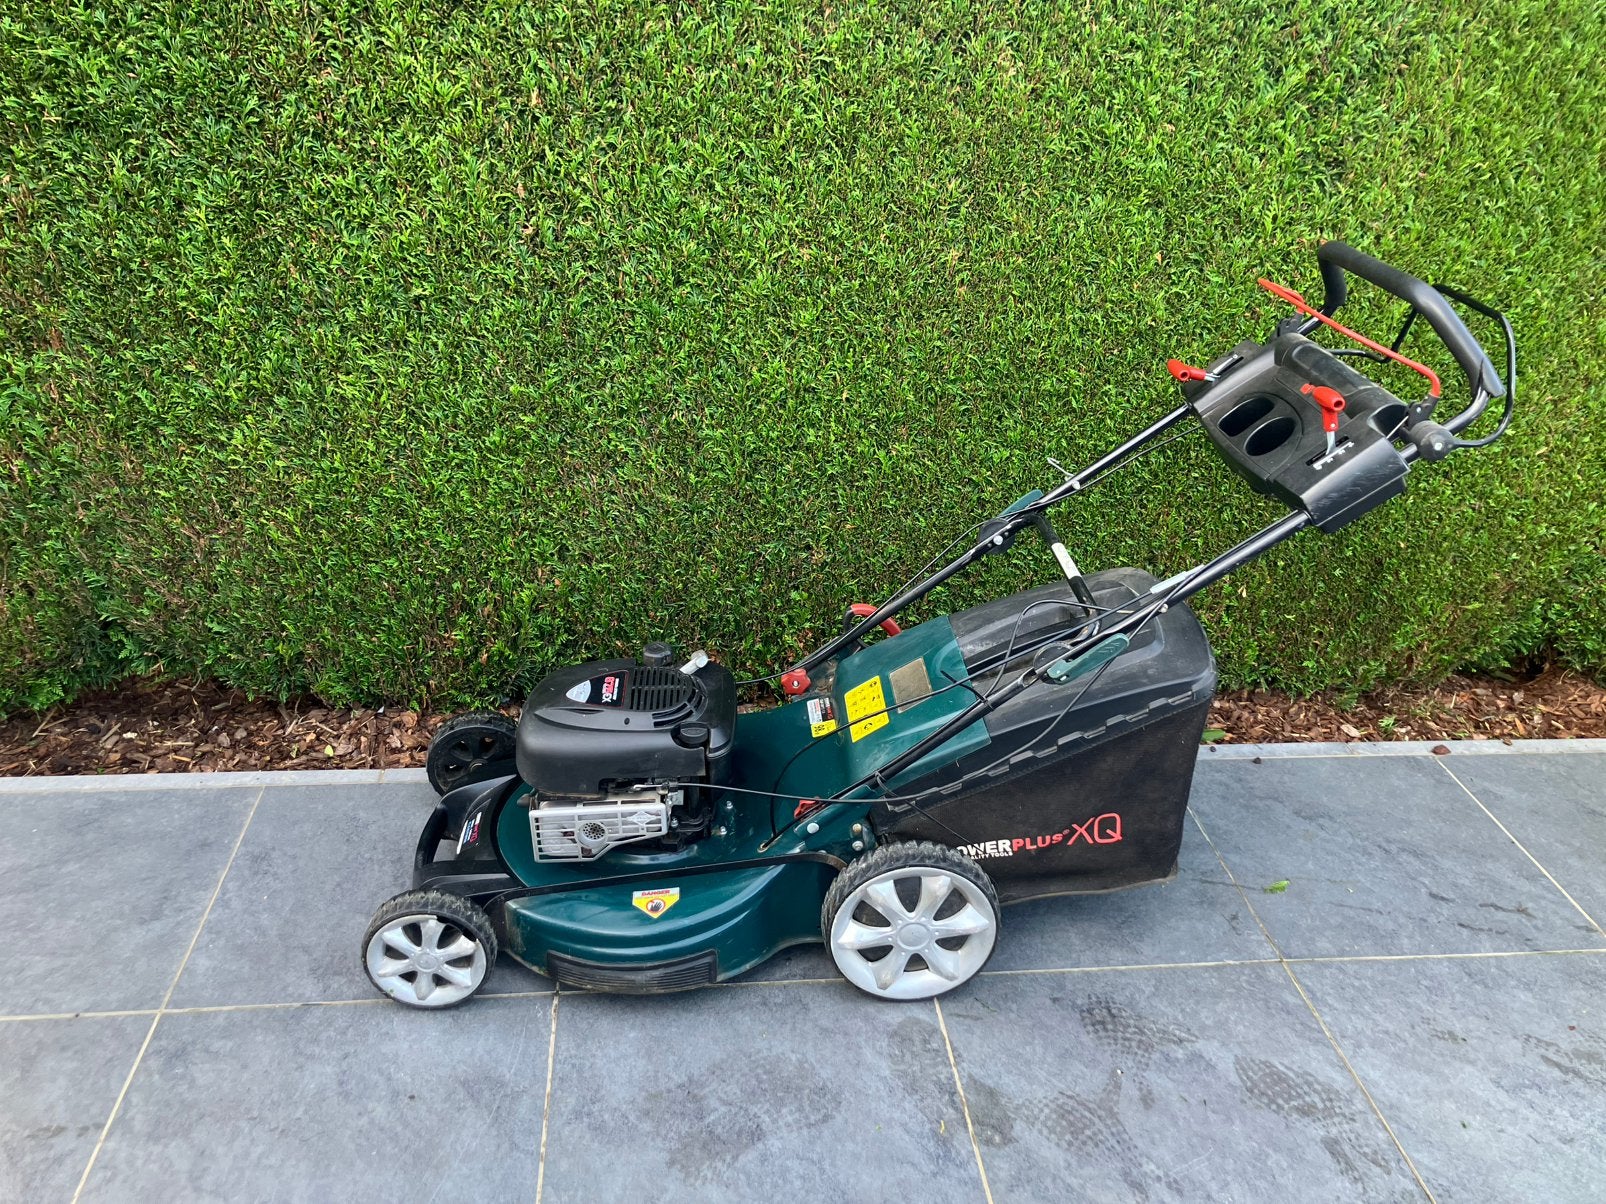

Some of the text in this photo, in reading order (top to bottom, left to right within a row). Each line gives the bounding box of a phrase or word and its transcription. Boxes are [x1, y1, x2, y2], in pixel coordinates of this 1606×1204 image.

[956, 812, 1122, 856] OWERPLUS XQ
[641, 889, 671, 897] DANGER
